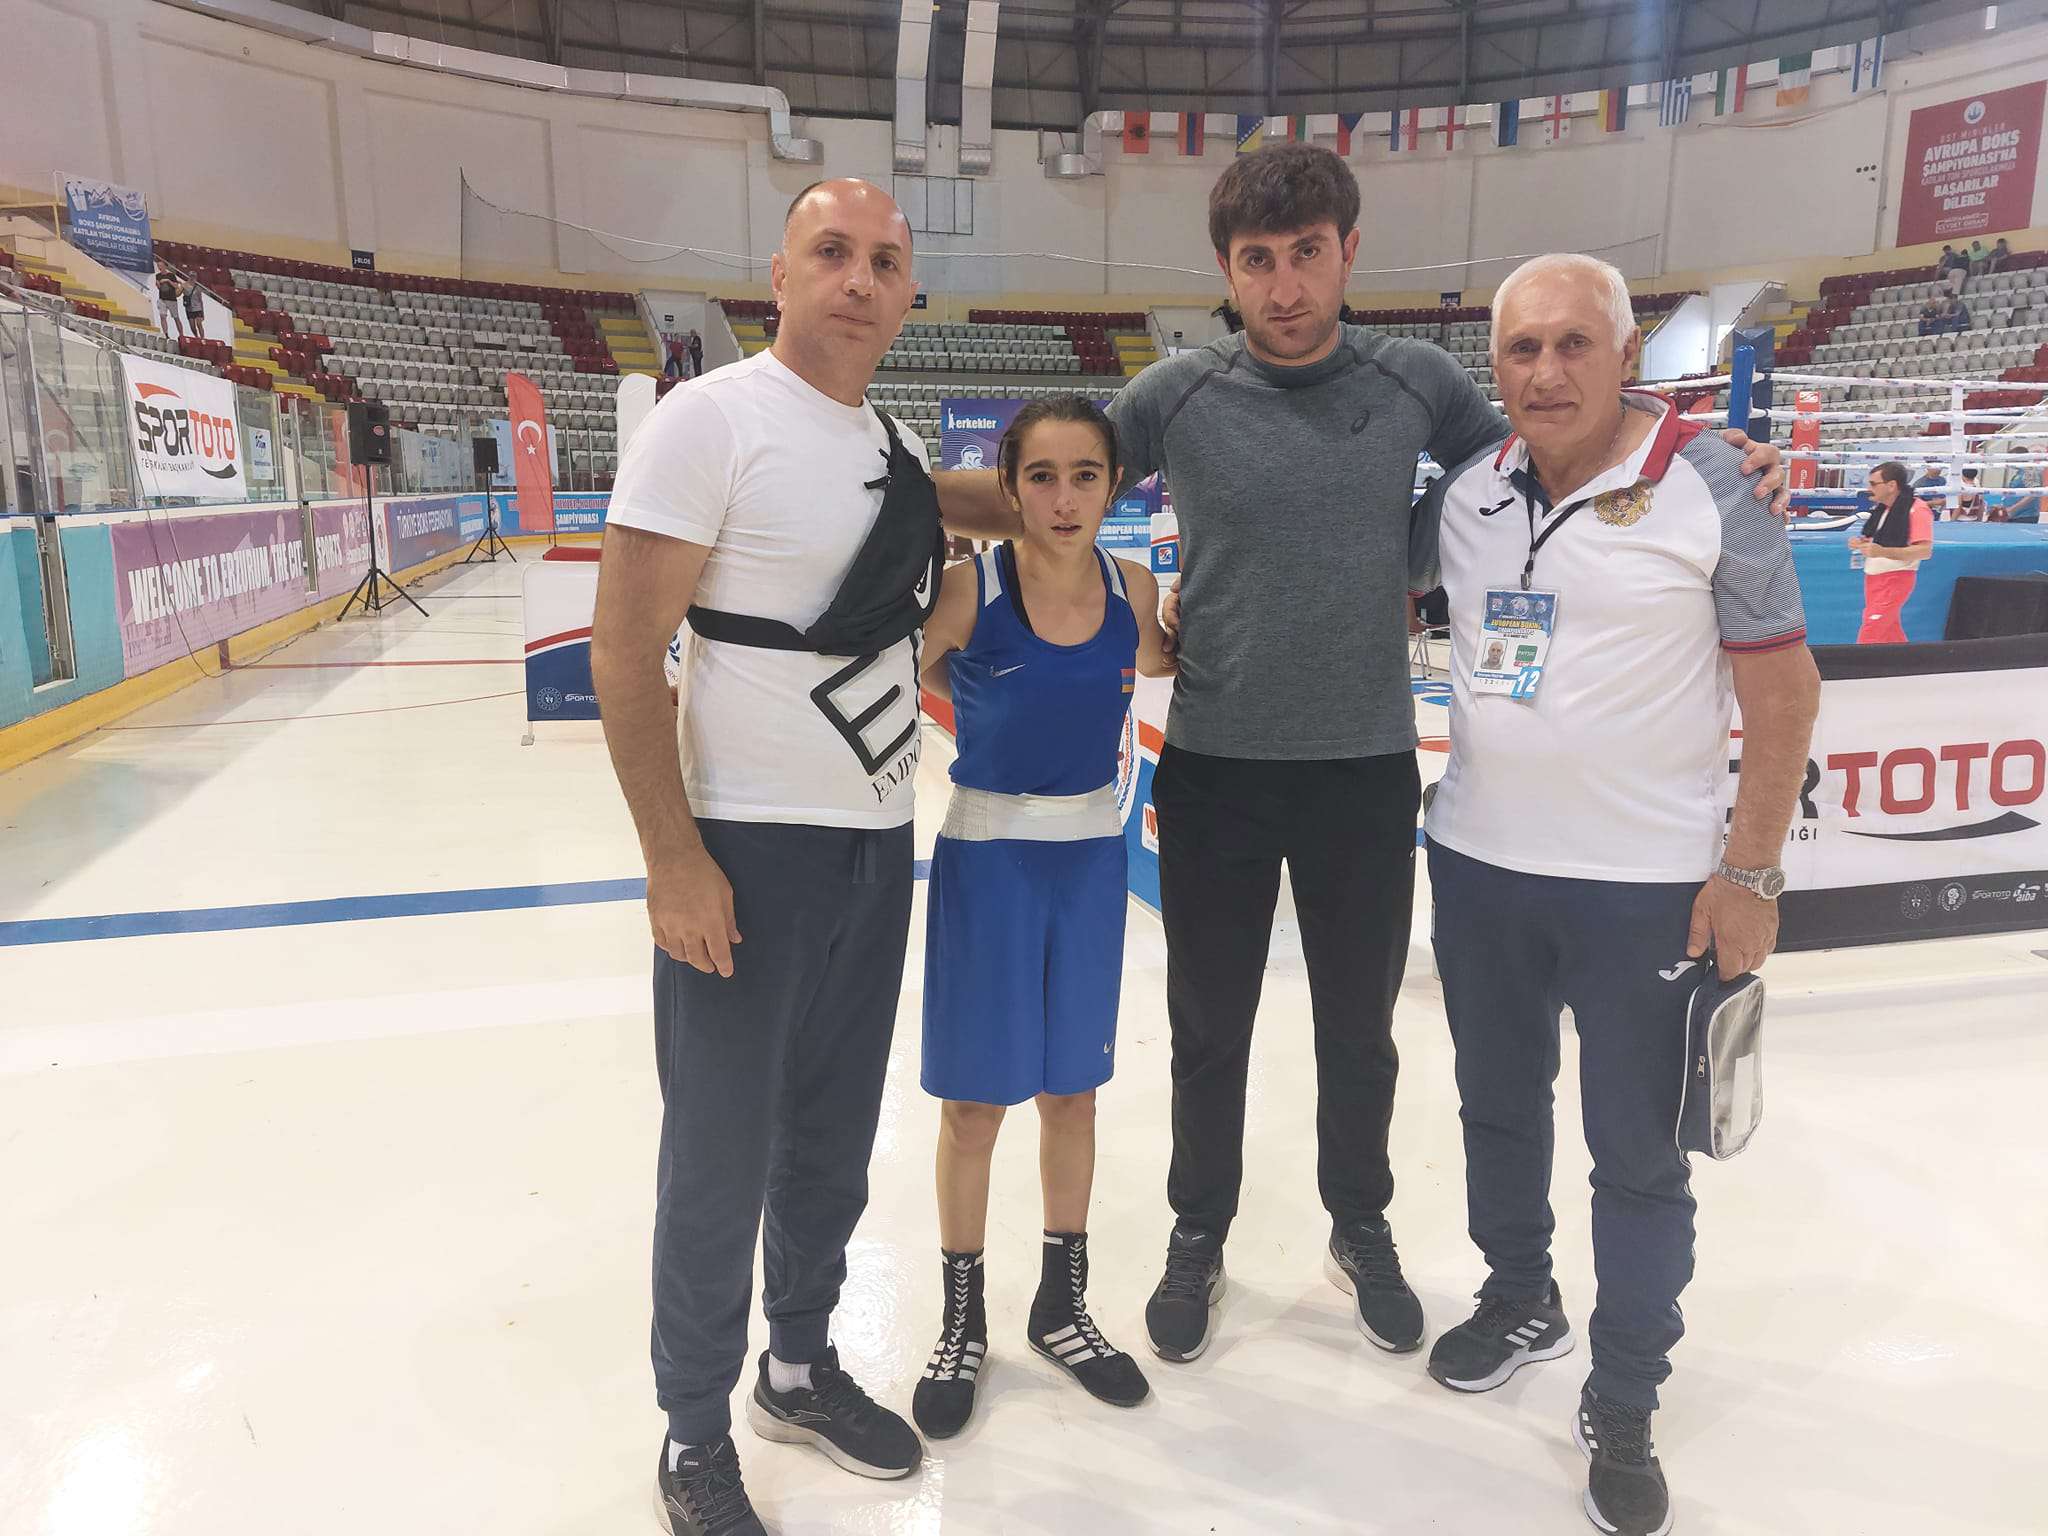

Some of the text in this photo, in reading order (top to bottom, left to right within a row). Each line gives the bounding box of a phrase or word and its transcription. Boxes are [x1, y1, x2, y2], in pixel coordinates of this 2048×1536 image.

[1924, 129, 2020, 162] AVRUPA BOKS
[1934, 175, 1999, 198] BAŞARILAR
[955, 417, 998, 429] erkekler
[127, 557, 205, 625] WELCOME
[202, 554, 221, 603] TO
[272, 541, 290, 583] THE
[288, 540, 303, 579] CIT
[1515, 670, 1541, 693] 12
